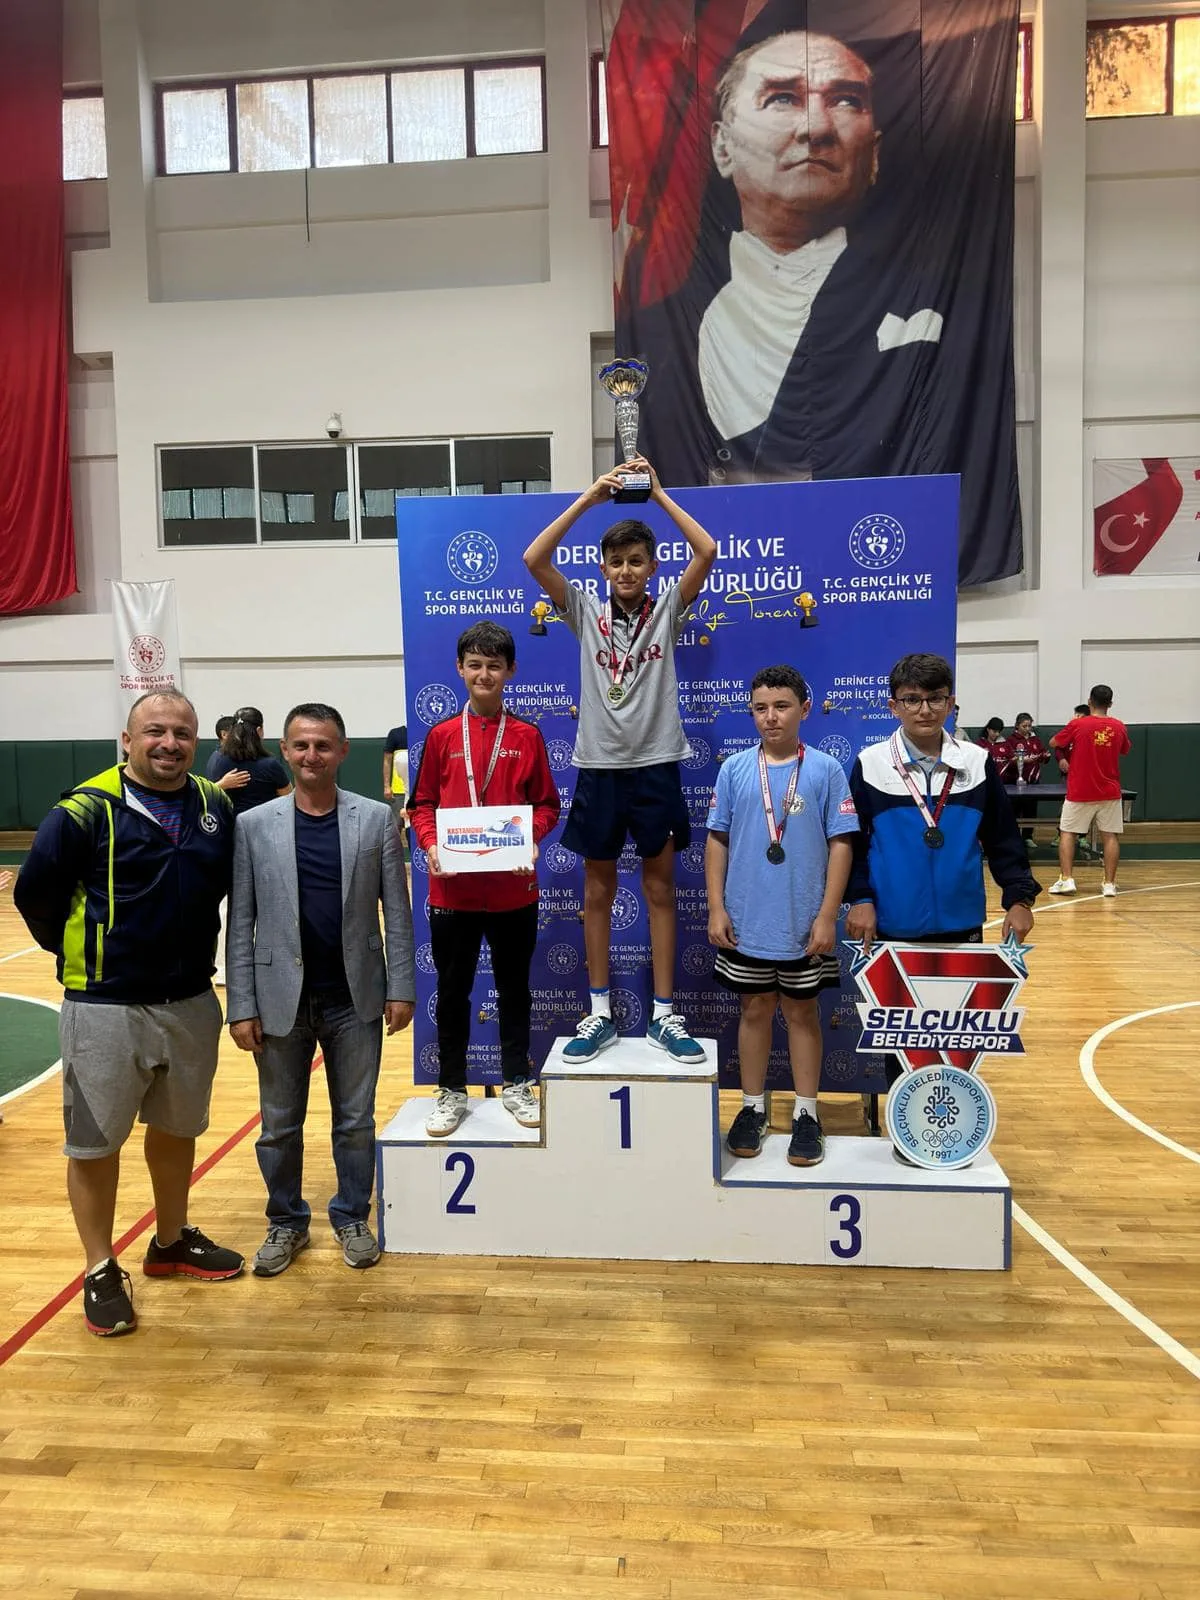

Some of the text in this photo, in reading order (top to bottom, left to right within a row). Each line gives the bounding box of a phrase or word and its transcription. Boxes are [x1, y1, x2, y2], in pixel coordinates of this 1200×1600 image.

[656, 534, 751, 562] GENLİK
[757, 537, 785, 557] VE
[822, 574, 932, 591] T.C. GENÇLİK VE
[424, 588, 524, 603] T.C. GENÇLİK VE
[822, 587, 932, 604] SPOR BAKANLIĞI
[425, 601, 525, 615] SPOR BAKANLIĞI
[691, 678, 731, 691] GENÇLİK
[732, 680, 744, 689] VE
[834, 675, 875, 686] DERİNCE
[515, 682, 553, 695] GENÇLİK
[555, 684, 567, 693] VE
[826, 690, 852, 700] SPOR
[855, 688, 875, 701] İLÇE
[503, 695, 573, 708] ÇE MÜDÜRLÜĞÜ
[679, 691, 751, 705] ÇE MÜDÜRLÜĞÜ
[558, 787, 569, 796] VE
[562, 889, 574, 897] VE
[675, 887, 697, 898] İNCE
[538, 900, 581, 911] DÜRLÜĞÜ
[564, 990, 577, 999] VE
[672, 989, 700, 1000] RİNCE
[702, 1003, 740, 1014] MÜDÜRL
[866, 1008, 1019, 1033] SELÇUKLU
[897, 1092, 919, 1147] SELÇUKLU
[908, 1072, 982, 1104] BELEDİYESPOR
[609, 1086, 632, 1149] 1
[930, 1150, 952, 1160] 1997
[444, 1152, 476, 1215] 2
[829, 1194, 862, 1258] 3
